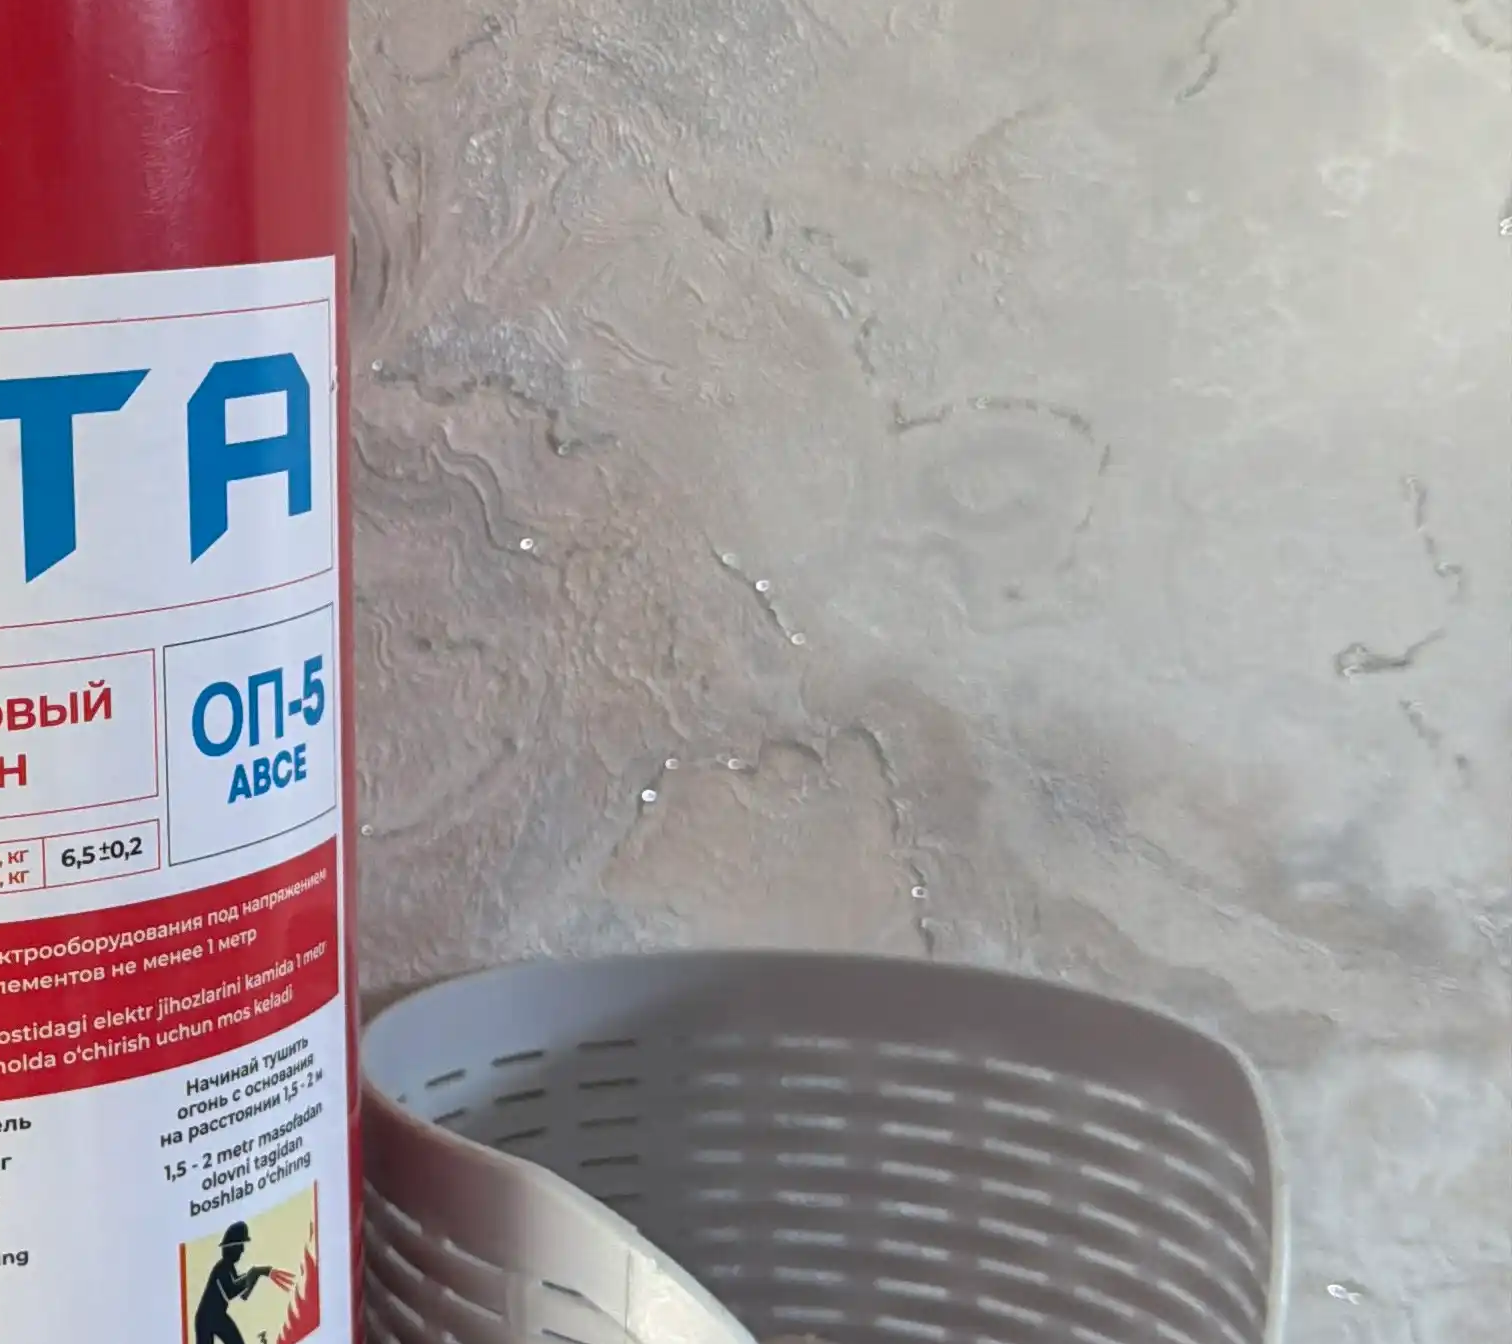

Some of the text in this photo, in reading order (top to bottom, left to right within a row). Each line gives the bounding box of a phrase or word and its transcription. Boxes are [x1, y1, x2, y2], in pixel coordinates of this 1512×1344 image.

[192, 654, 325, 757] ОП-5
[8, 849, 28, 865] КГ
[9, 870, 29, 885] КГ
[61, 837, 143, 869] 6,5±0,2
[208, 906, 239, 926] под
[243, 868, 326, 915] напряжением
[112, 960, 136, 977] не
[144, 945, 203, 971] менее
[219, 928, 257, 952] метр
[94, 1006, 153, 1030] elektr
[157, 976, 240, 1021] jihozlarini
[245, 959, 294, 991] kamida
[303, 941, 325, 965] metr
[157, 1019, 213, 1046] uchun
[218, 1006, 251, 1029] mos
[254, 984, 292, 1016] keladi
[178, 1095, 228, 1120] огонь
[245, 1053, 313, 1097] основания
[187, 1037, 308, 1097] Начинай тушить
[161, 1080, 298, 1147] на расстоянии 1,5
[164, 1160, 186, 1182] 1,5
[217, 1139, 254, 1165] metr
[259, 1102, 322, 1148] masofadan
[202, 1136, 302, 1191] olovni tagidan
[190, 1180, 253, 1217] boshlab
